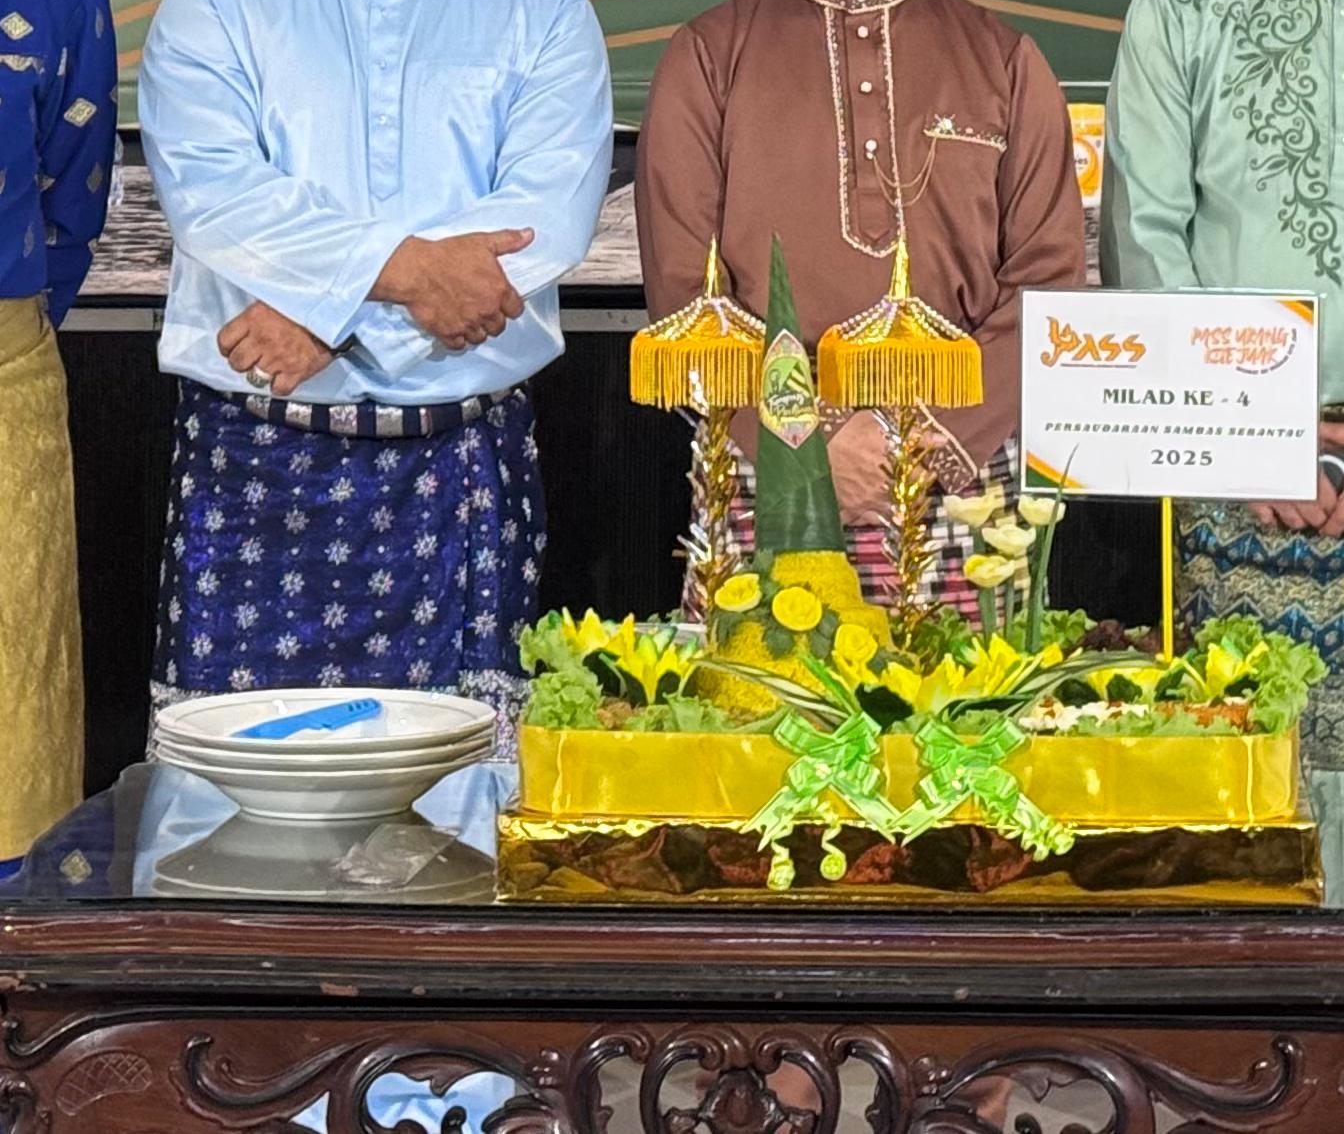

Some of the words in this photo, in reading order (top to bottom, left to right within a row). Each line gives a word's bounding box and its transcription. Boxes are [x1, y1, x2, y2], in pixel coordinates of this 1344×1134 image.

[1102, 388, 1175, 405] MILAD
[1183, 389, 1213, 406] KE
[1236, 391, 1251, 407] 4
[1045, 422, 1158, 434] PERSAUDARAAN
[1163, 425, 1223, 435] SAMBAS
[1151, 449, 1213, 466] 2025
